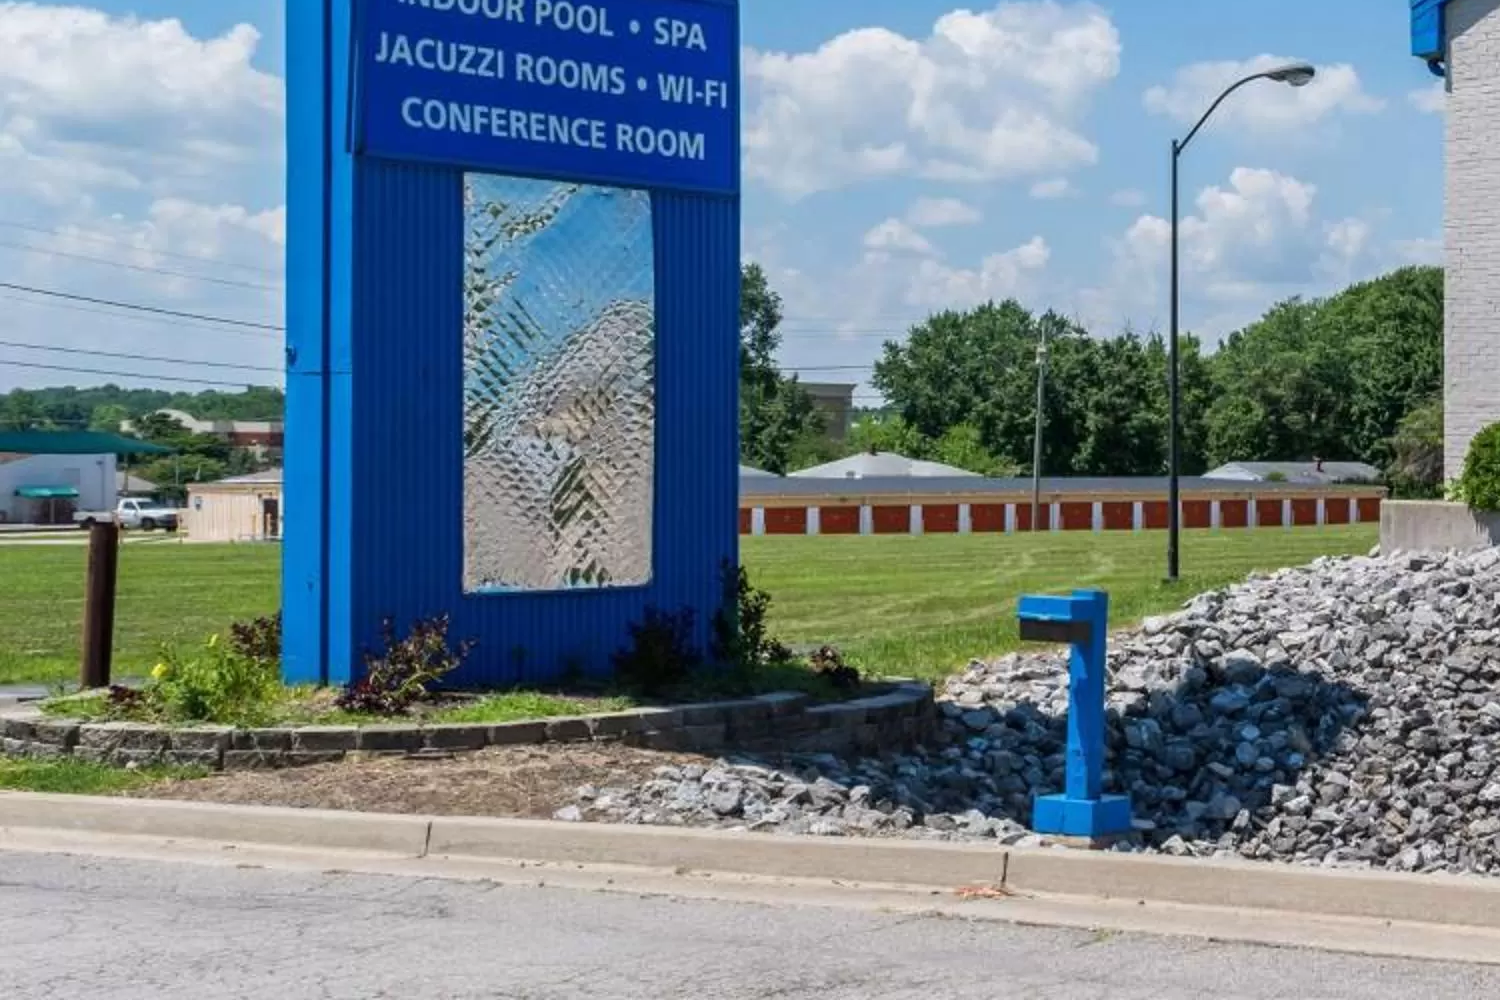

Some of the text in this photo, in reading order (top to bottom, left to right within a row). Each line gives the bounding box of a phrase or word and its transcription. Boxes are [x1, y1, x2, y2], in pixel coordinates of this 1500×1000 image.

[654, 17, 707, 52] SPA
[375, 31, 728, 109] JACUZZI ROOMS WI-FI
[401, 96, 706, 160] CONFERENCE ROOM
